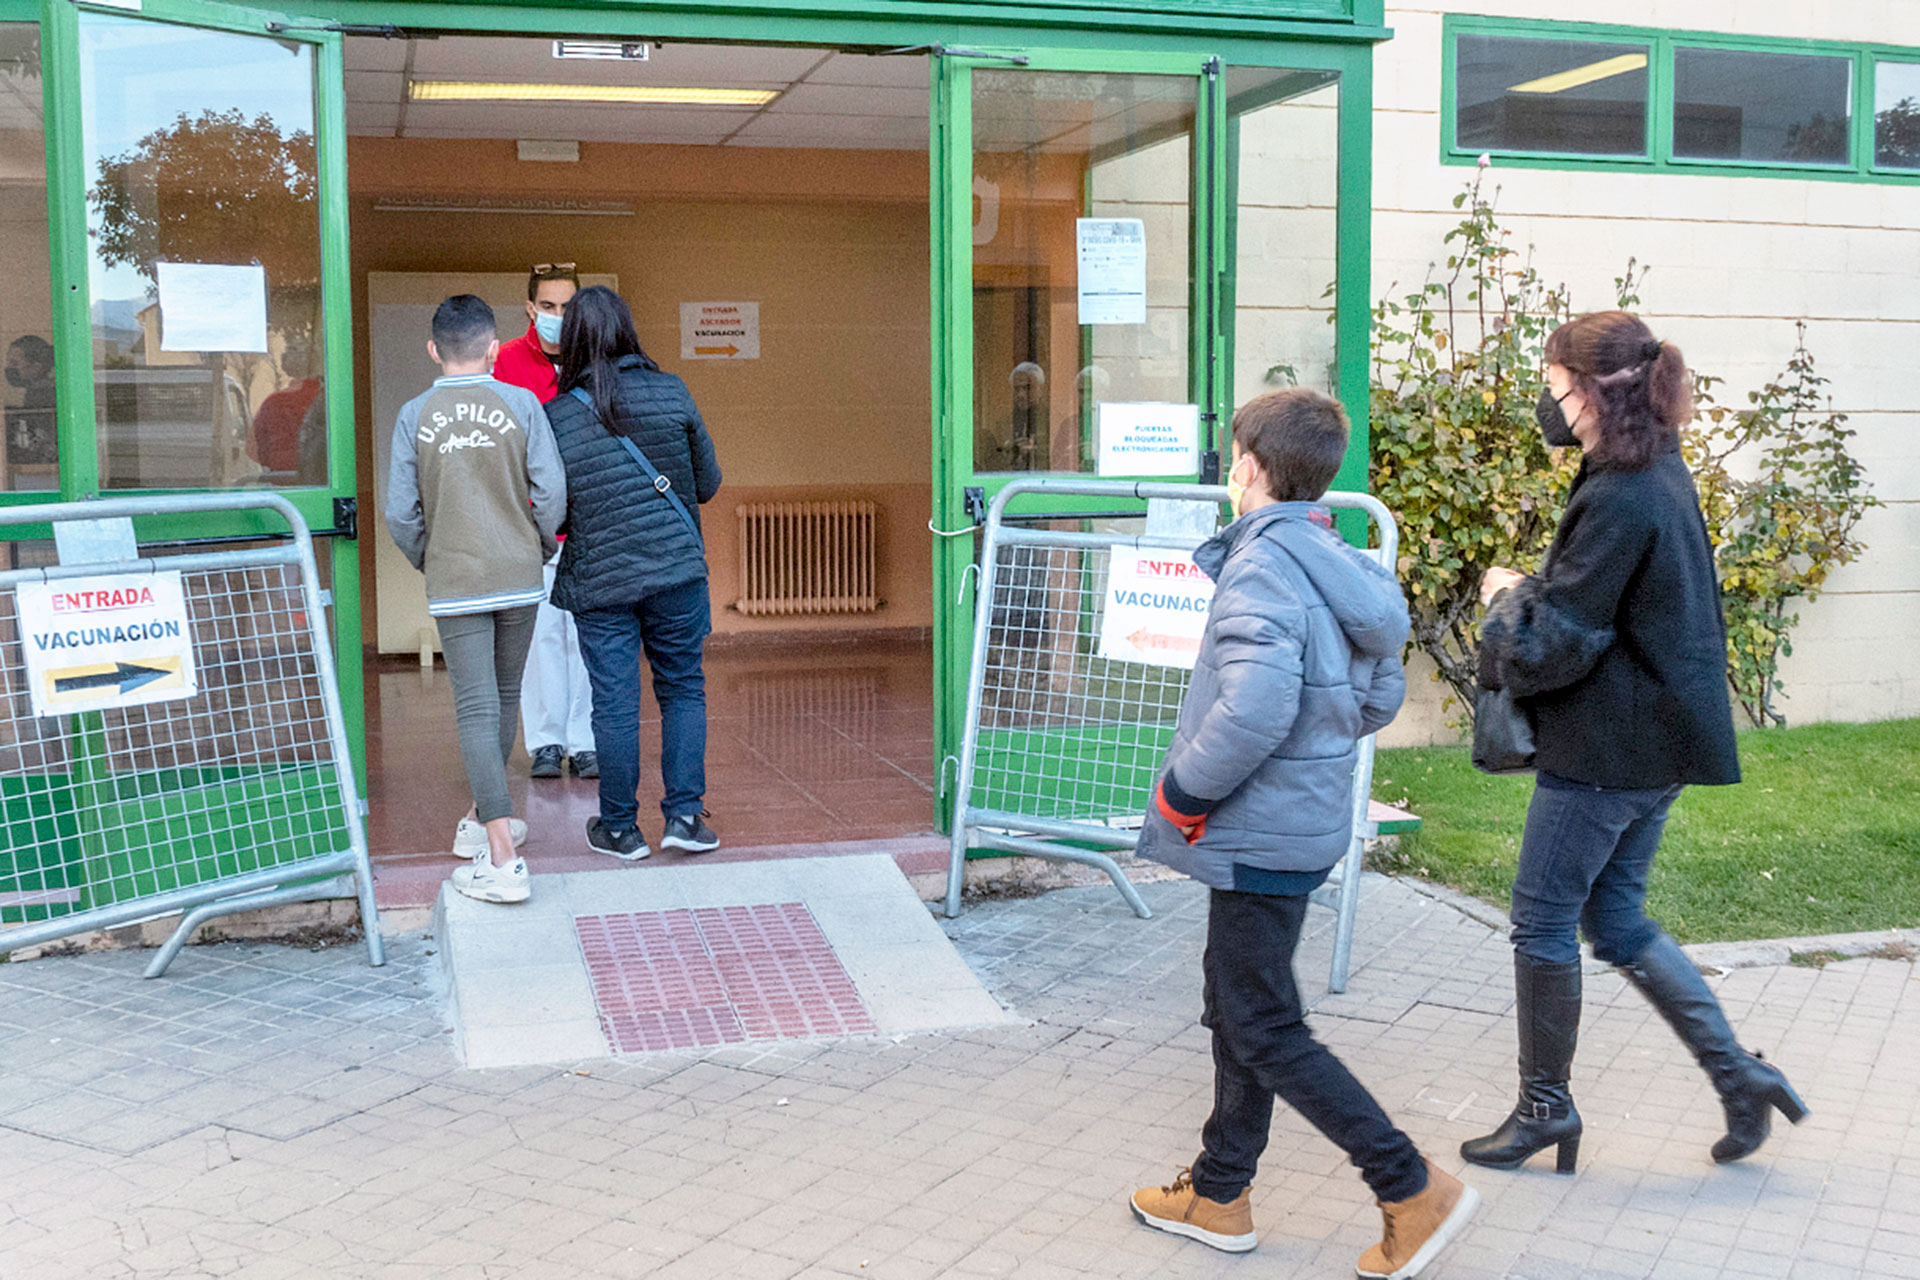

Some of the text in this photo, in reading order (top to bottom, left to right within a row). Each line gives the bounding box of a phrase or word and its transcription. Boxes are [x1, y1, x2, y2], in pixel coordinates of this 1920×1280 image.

[417, 410, 454, 444] U.S.
[455, 403, 517, 435] PILOT
[1134, 425, 1173, 433] PUERTAS
[1123, 434, 1179, 443] BLOQUEADAS
[51, 586, 155, 612] ENTRADA
[33, 618, 181, 651] VACUNACIÓN
